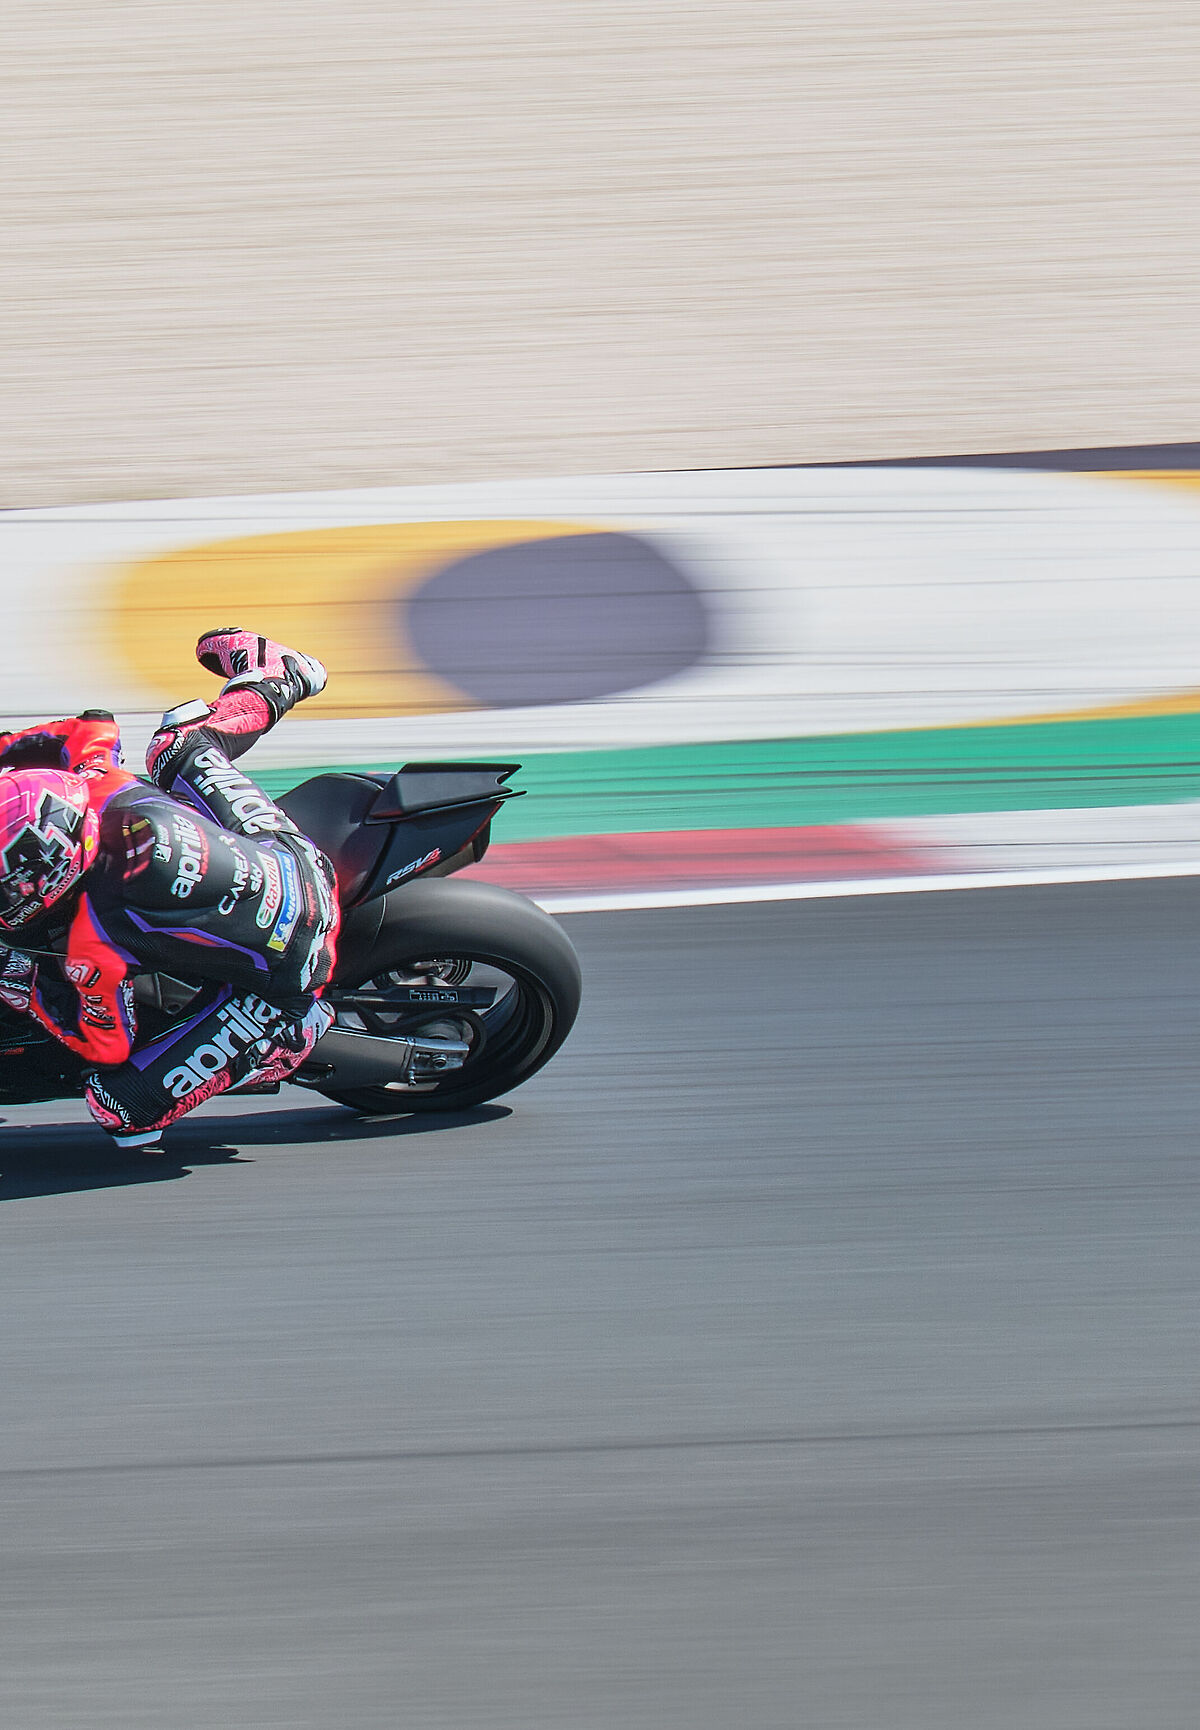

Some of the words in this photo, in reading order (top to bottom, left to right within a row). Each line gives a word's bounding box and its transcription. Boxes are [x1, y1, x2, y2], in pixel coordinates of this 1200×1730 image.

[194, 747, 282, 834] aprilia
[170, 814, 203, 899] aprilia
[265, 856, 280, 909] Castrol
[286, 856, 296, 922] MICHELIN
[7, 901, 42, 926] aprilia
